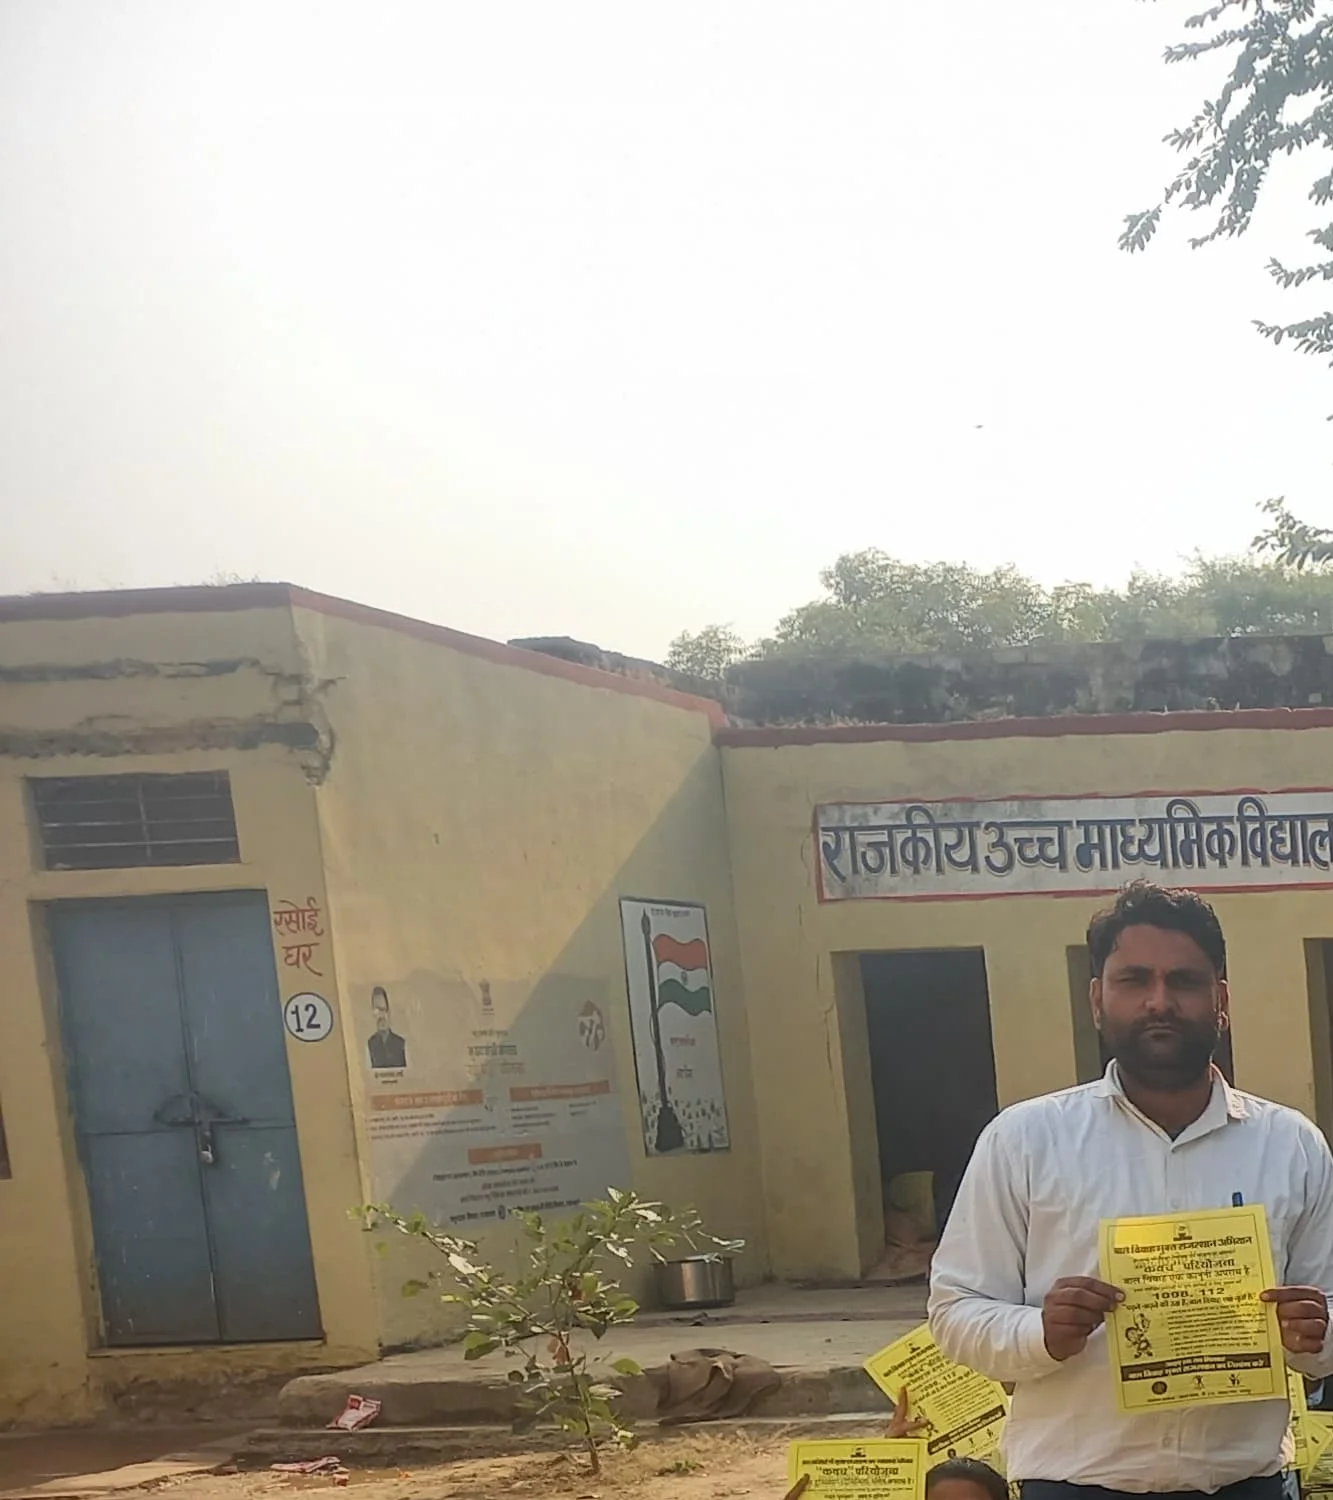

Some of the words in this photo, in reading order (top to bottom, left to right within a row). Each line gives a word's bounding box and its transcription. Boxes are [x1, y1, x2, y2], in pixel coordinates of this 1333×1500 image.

[820, 805, 981, 883] राजकीय
[983, 819, 1074, 874] उच्च
[1076, 798, 1236, 869] माध्यमिक
[273, 896, 324, 936] रसोई
[282, 943, 323, 977] घर
[290, 1003, 321, 1033] 12
